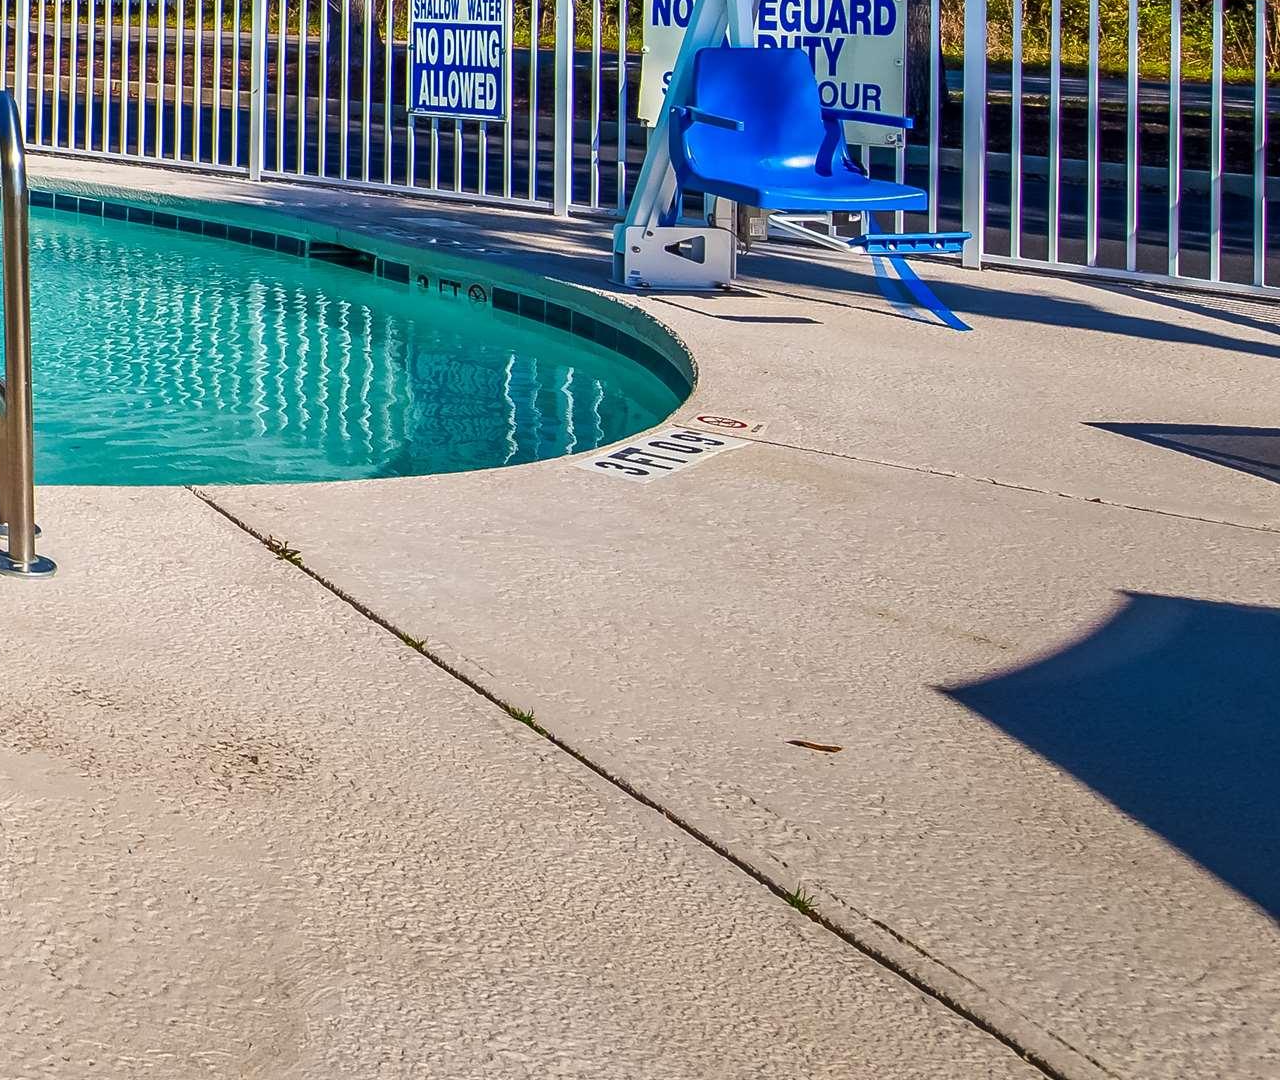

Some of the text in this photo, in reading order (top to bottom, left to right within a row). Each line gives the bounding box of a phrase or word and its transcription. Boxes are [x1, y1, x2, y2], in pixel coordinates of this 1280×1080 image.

[416, 27, 500, 68] NO DIVING
[418, 69, 497, 110] ALLOWED
[818, 80, 882, 112] OUR
[595, 461, 650, 476] 3
[607, 446, 689, 471] FT
